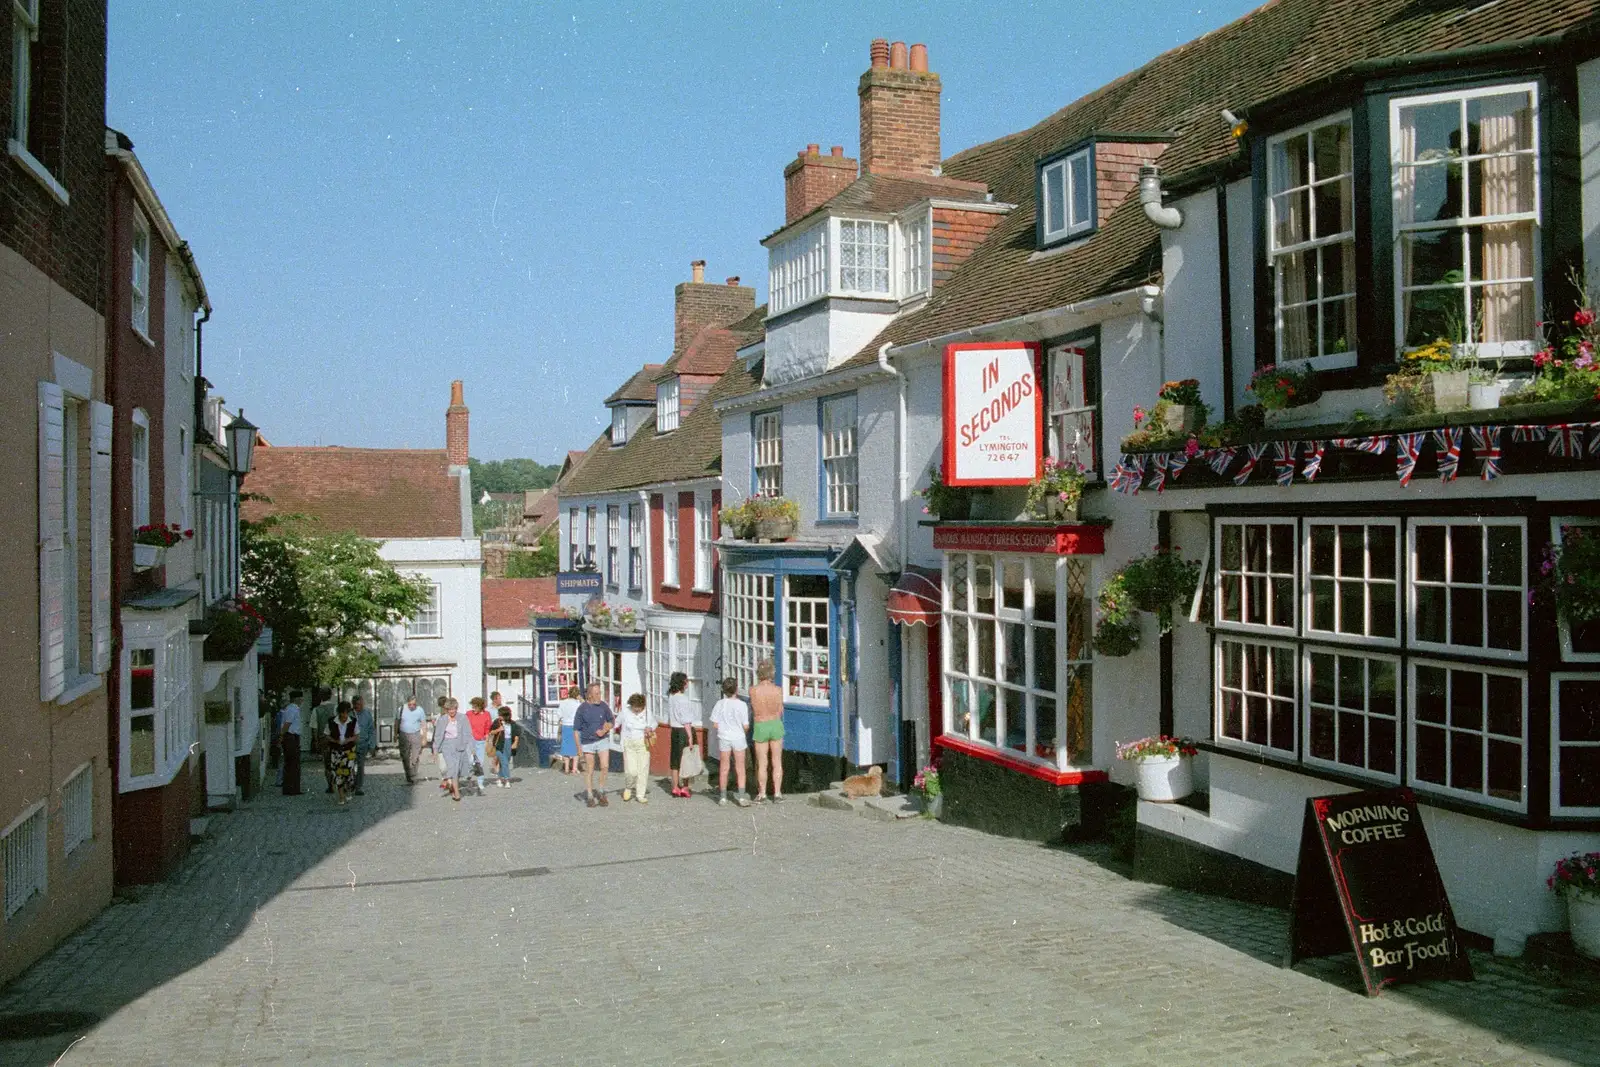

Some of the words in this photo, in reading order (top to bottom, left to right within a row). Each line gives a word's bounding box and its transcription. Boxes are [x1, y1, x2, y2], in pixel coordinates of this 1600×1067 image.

[982, 356, 999, 394] IN
[960, 373, 1032, 447] SECONDS
[979, 442, 1028, 451] LYMINGTON
[987, 453, 1020, 461] 72647
[1022, 534, 1056, 547] SECONDS
[560, 579, 599, 588] SHIPMATES
[1327, 805, 1409, 832] MORNING
[1341, 824, 1405, 844] COFFEE
[1360, 923, 1392, 944] Hot
[1406, 912, 1445, 934] Cold
[1370, 946, 1404, 967] Bar
[1404, 938, 1449, 970] Food
